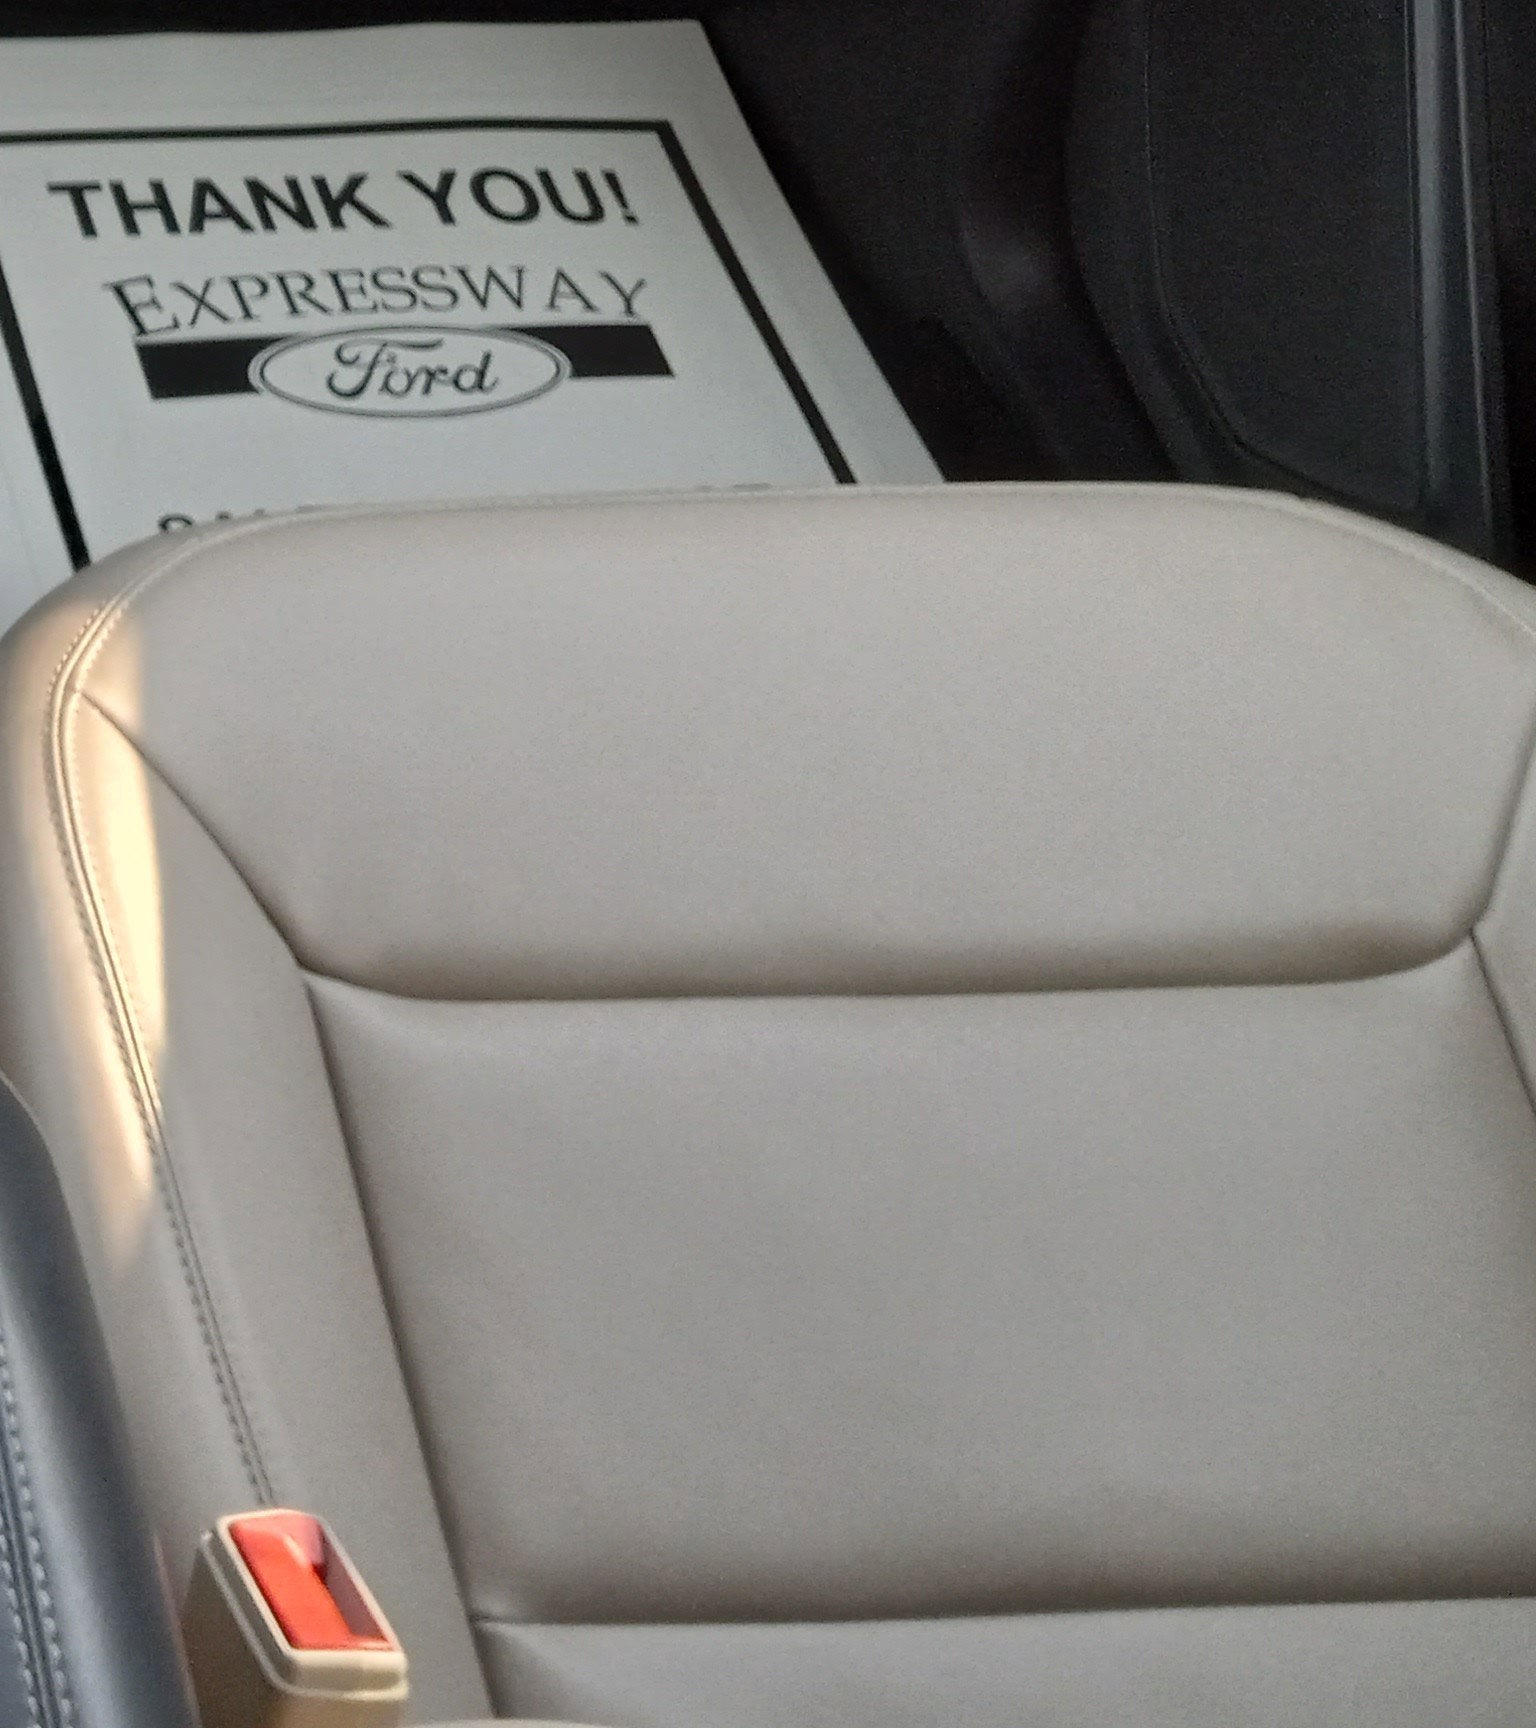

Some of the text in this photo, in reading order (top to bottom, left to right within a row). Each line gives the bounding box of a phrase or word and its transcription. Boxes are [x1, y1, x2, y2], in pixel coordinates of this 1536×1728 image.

[45, 167, 641, 240] THANK YOU!
[102, 264, 649, 338] EXPRESSWAY
[325, 336, 499, 401] Ford
